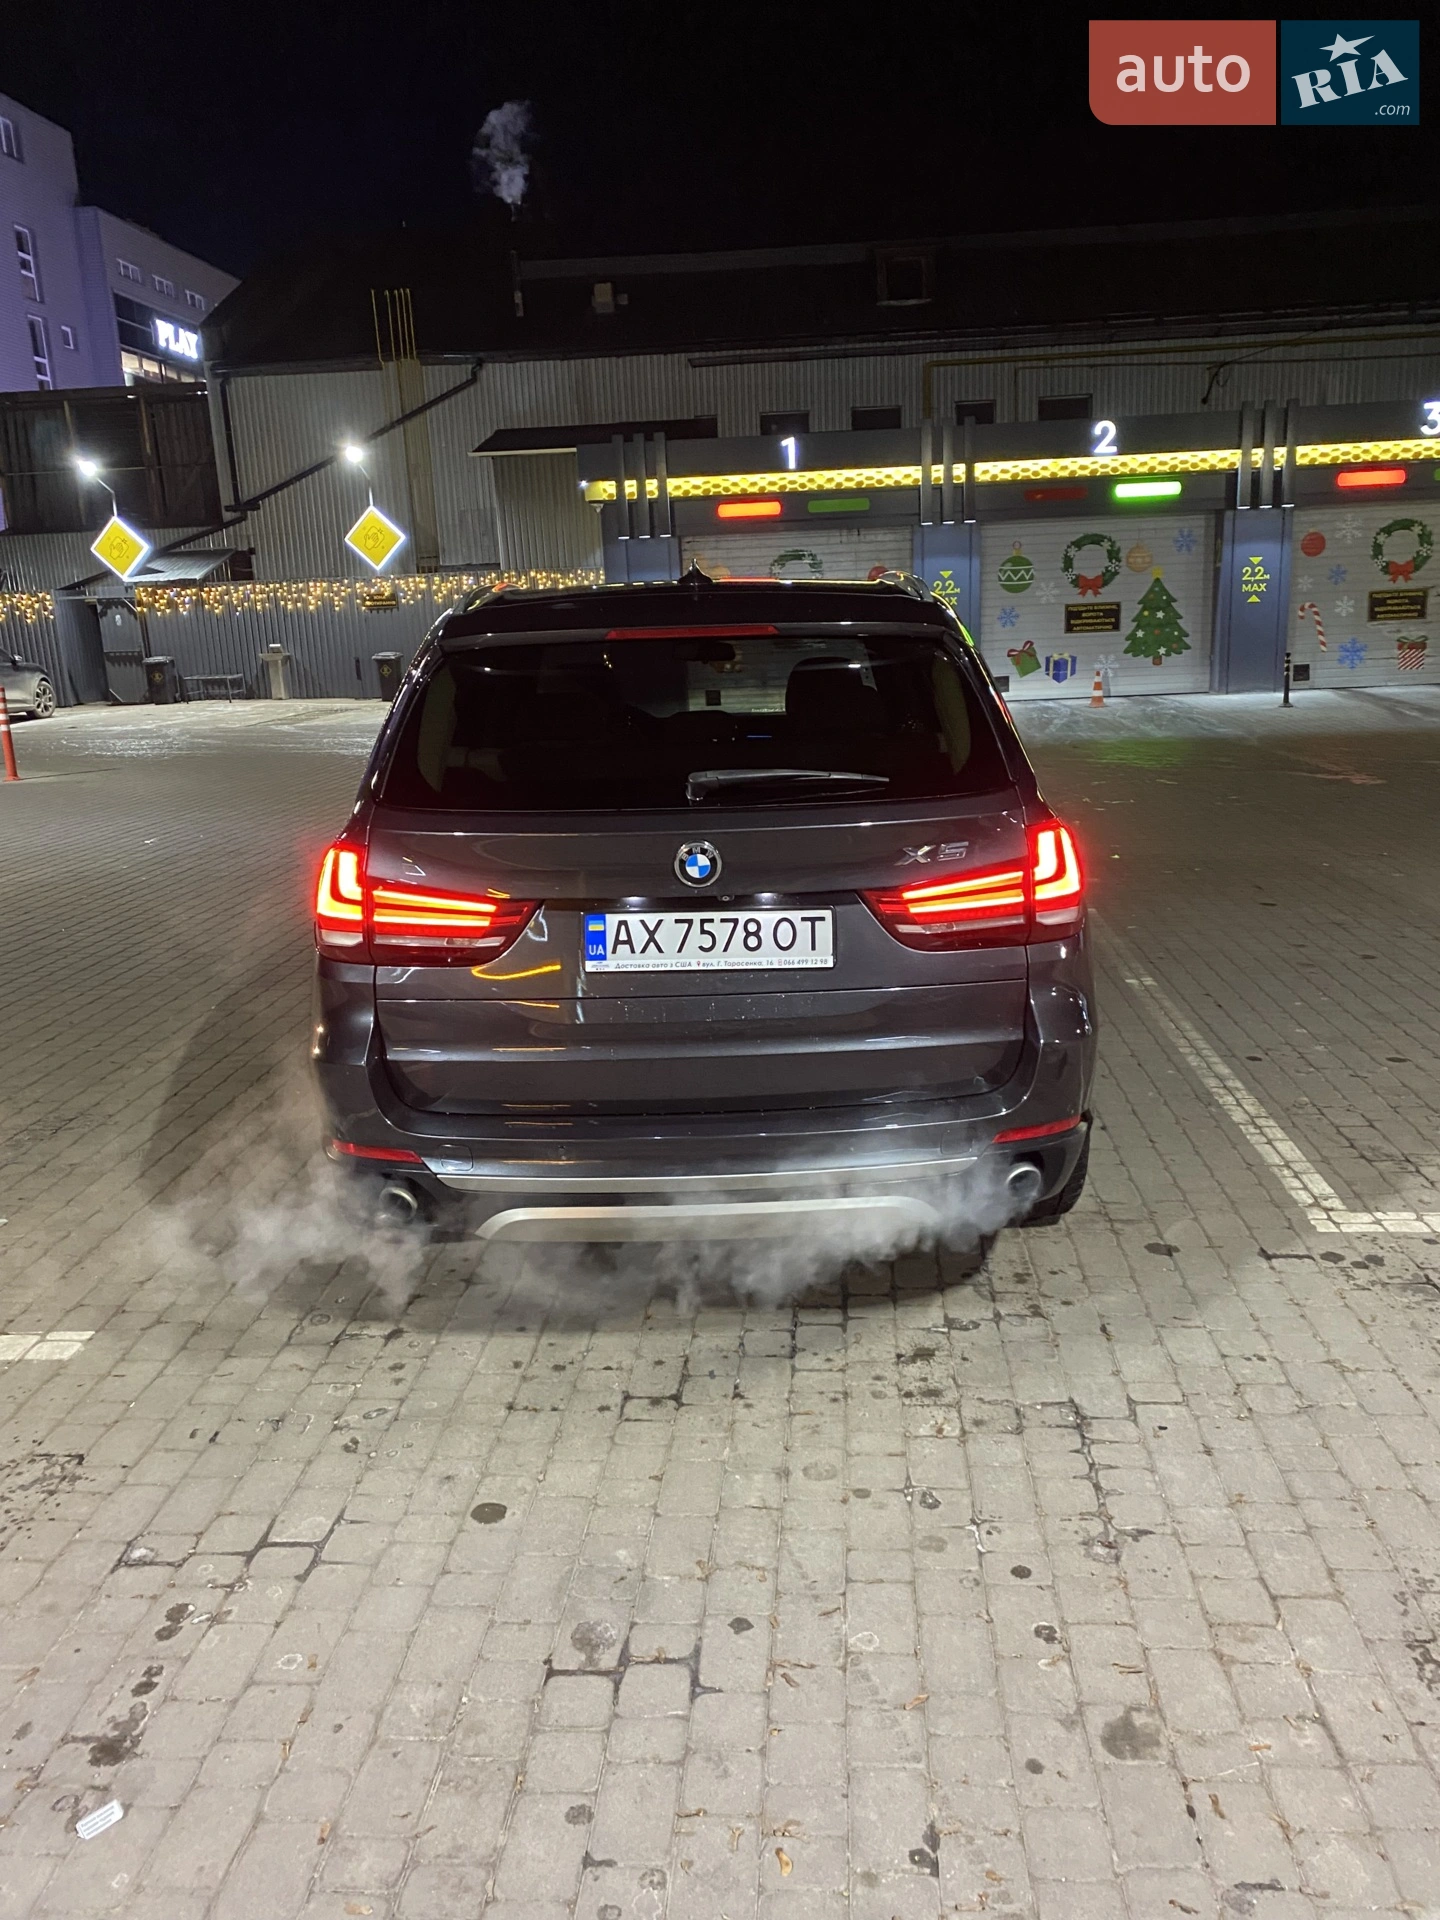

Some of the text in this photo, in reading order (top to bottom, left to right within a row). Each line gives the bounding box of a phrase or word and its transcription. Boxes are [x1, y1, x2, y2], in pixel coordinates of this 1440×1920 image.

[1420, 401, 1440, 435] 3
[780, 436, 797, 470] 1
[1094, 420, 1118, 454] 2
[681, 846, 714, 861] BMW
[894, 841, 969, 866] X5
[588, 944, 605, 956] UA
[611, 916, 826, 954] AX 7578 OT
